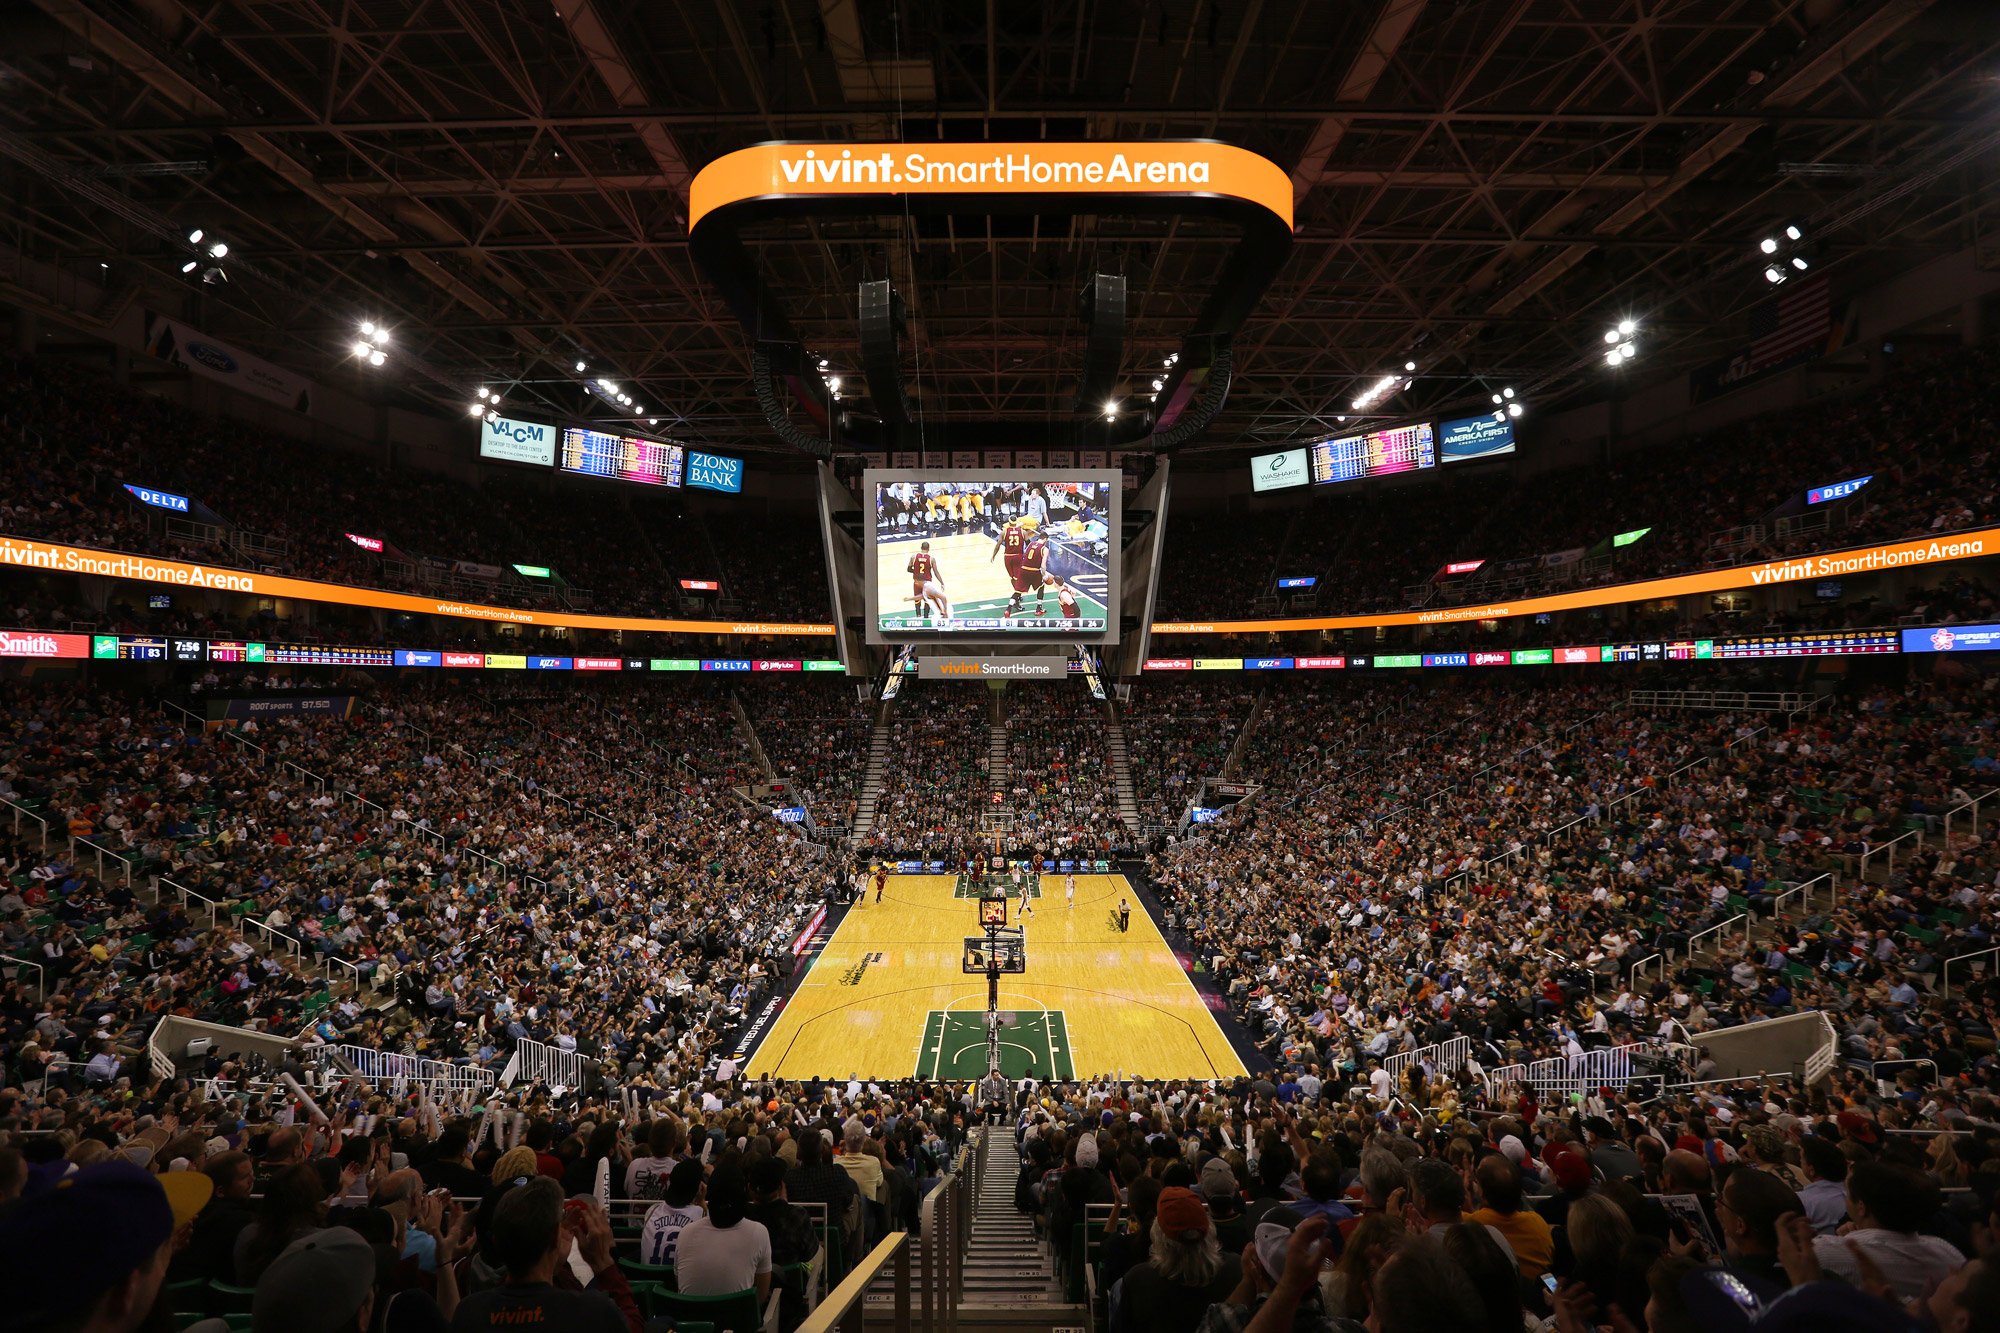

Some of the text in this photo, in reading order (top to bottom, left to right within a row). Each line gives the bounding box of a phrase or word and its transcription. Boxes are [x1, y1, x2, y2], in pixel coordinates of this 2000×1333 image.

[1444, 426, 1509, 444] AMERICA FIRST
[692, 453, 737, 472] ZIONS
[1260, 469, 1300, 480] WASHAKIE
[141, 490, 186, 509] DELTA
[1009, 535, 1020, 546] 23
[174, 641, 200, 652] 7:56
[147, 648, 161, 658] 83
[212, 650, 224, 660] 81
[1435, 655, 1467, 665] DELTA
[249, 703, 270, 711] ROOT
[986, 909, 1002, 922] 24
[734, 995, 783, 1053] UNITED FUEL SUPPLY
[653, 1212, 693, 1231] STOCKTO
[649, 1231, 680, 1265] 12
